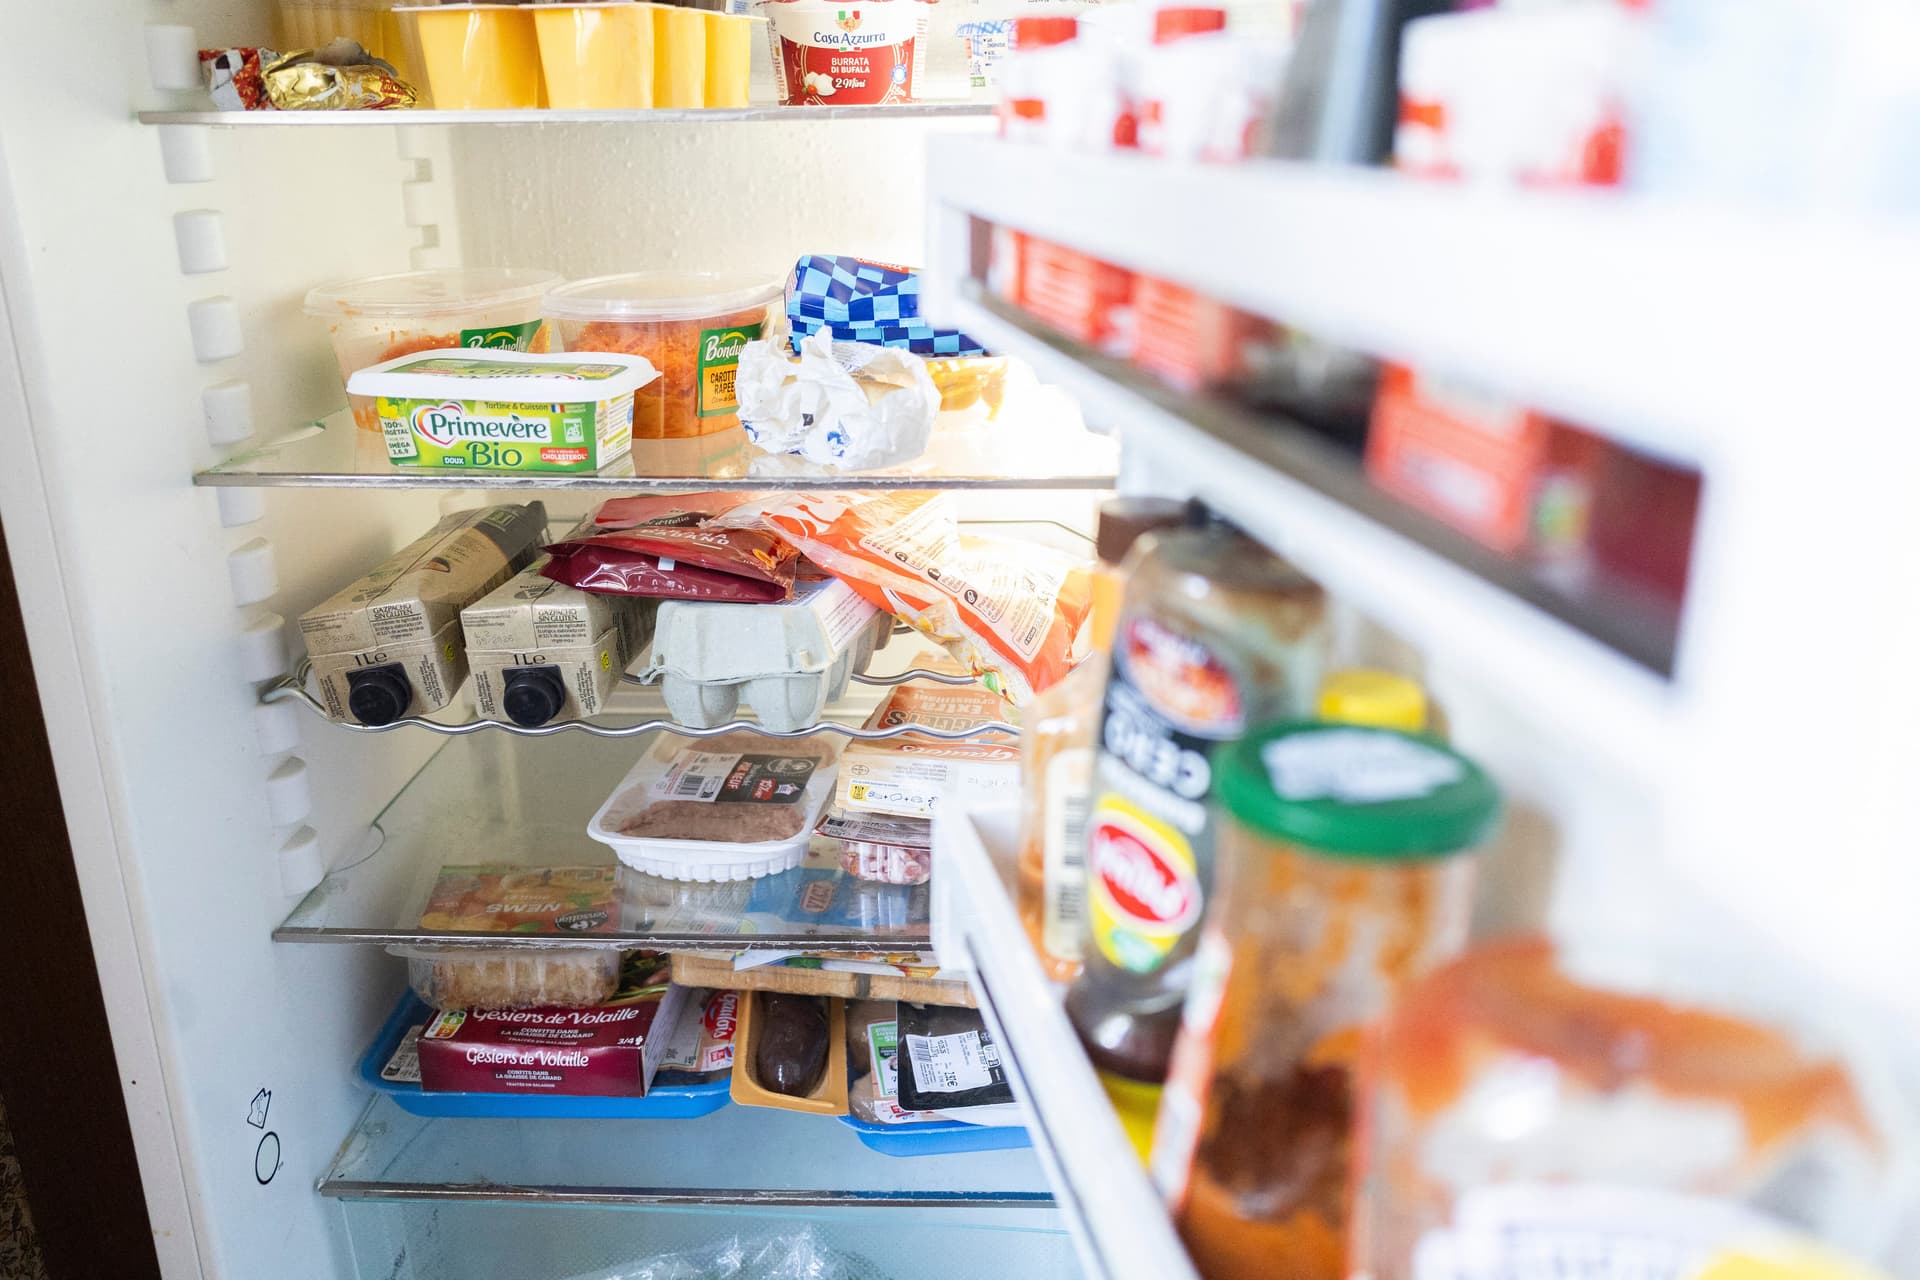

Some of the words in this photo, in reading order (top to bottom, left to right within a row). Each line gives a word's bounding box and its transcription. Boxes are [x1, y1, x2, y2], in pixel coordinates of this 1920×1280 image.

[814, 32, 839, 44] Casa
[841, 33, 886, 46] Azzurra
[831, 57, 870, 66] BURRATA
[835, 78, 842, 88] 2
[843, 78, 866, 88] Mini
[485, 401, 510, 410] Tartine
[520, 403, 549, 411] Cuisson
[430, 413, 548, 439] Primevère
[466, 441, 522, 467] Bio
[444, 456, 464, 465] DOUX
[373, 603, 411, 614] GAZPACHO
[537, 608, 577, 616] GAZPACHO
[374, 611, 385, 620] SIN
[386, 608, 413, 618] GLUTEN
[486, 903, 561, 913] NEMS
[545, 1012, 570, 1024] de
[568, 1008, 640, 1025] Volaille
[617, 1037, 634, 1045] 3/4
[466, 1048, 518, 1065] Gésiers
[519, 1051, 535, 1065] de
[536, 1050, 589, 1067] Volaille
